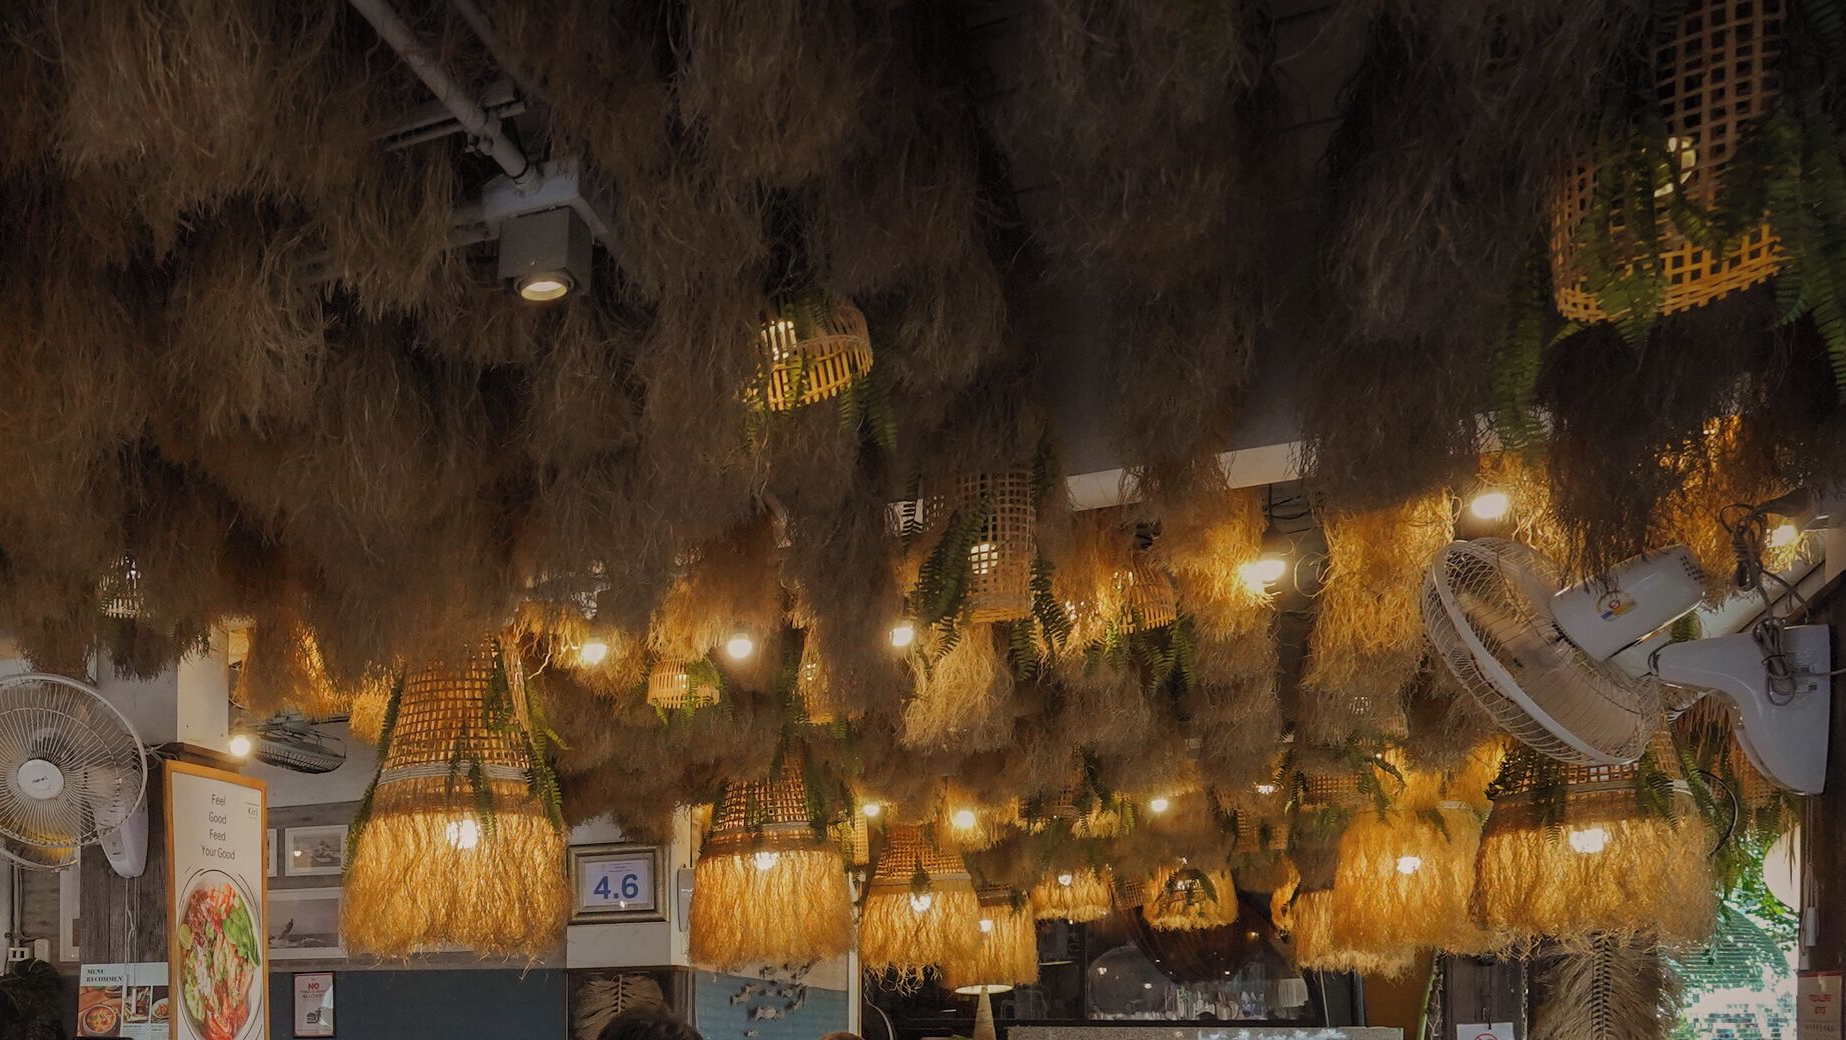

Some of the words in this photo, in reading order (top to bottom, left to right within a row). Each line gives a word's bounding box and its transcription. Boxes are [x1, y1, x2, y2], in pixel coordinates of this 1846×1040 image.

[211, 794, 226, 806] Feel
[208, 811, 227, 825] Good
[209, 829, 226, 841] Feed
[201, 845, 216, 857] Your
[217, 847, 236, 861] Good
[593, 873, 639, 900] 4.6
[308, 982, 320, 990] NO
